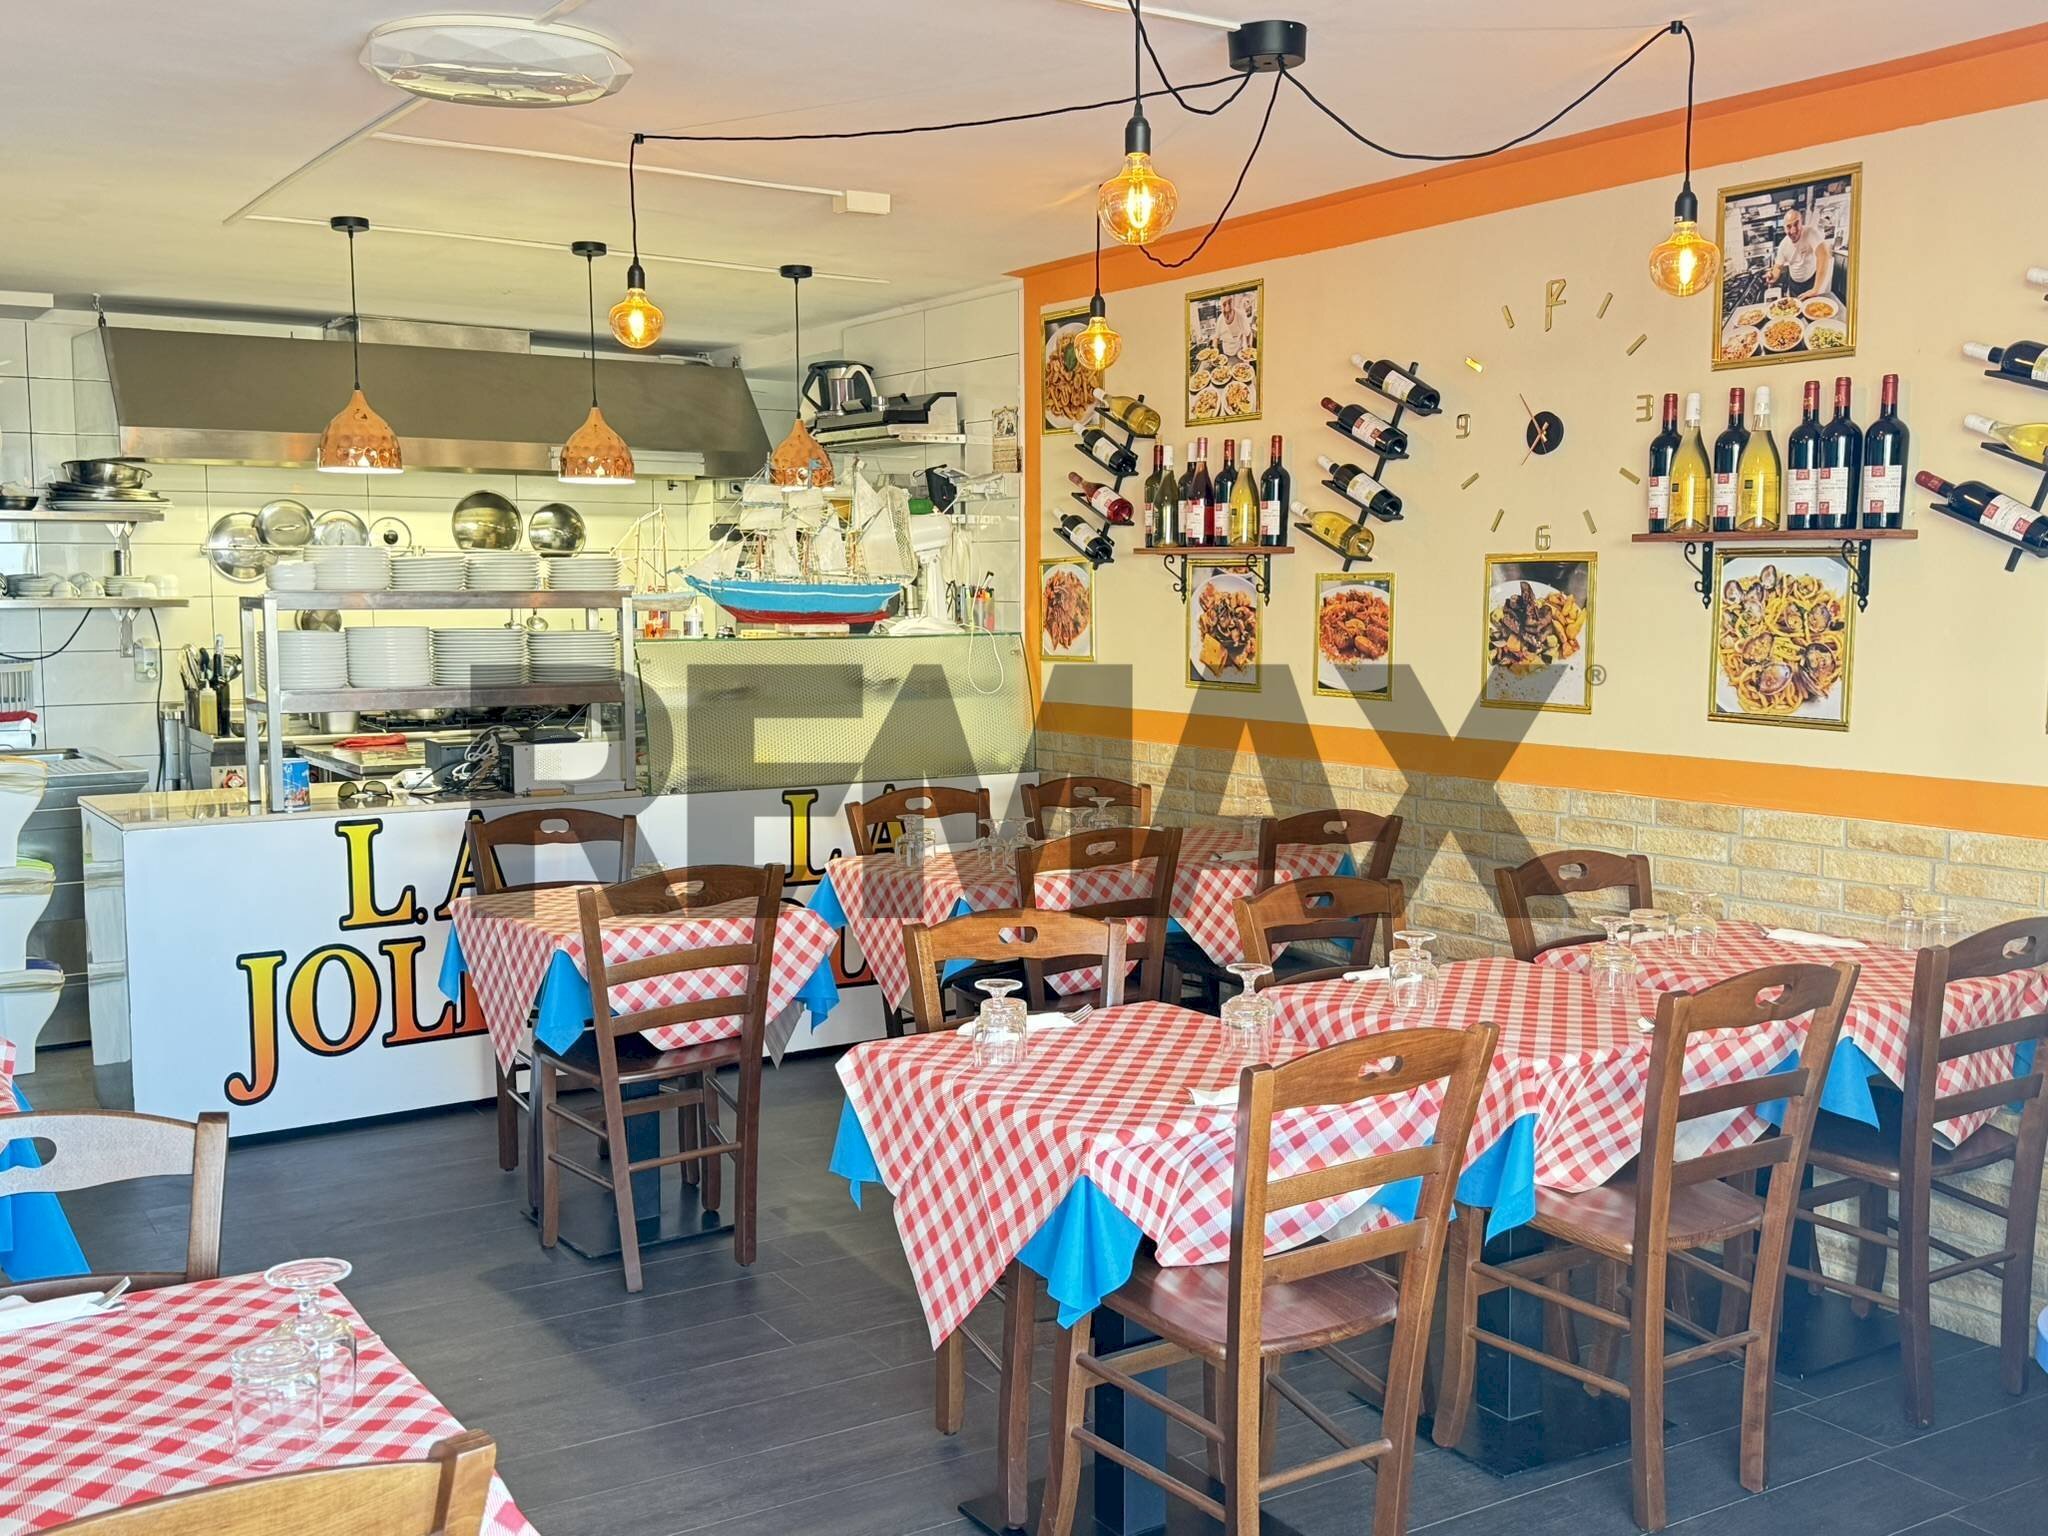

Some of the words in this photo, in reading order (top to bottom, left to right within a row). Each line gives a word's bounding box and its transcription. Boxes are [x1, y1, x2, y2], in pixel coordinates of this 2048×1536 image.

[1636, 394, 1654, 422] 3
[1456, 413, 1471, 439] 9
[1535, 524, 1551, 551] 6
[223, 936, 490, 1107] JOL
